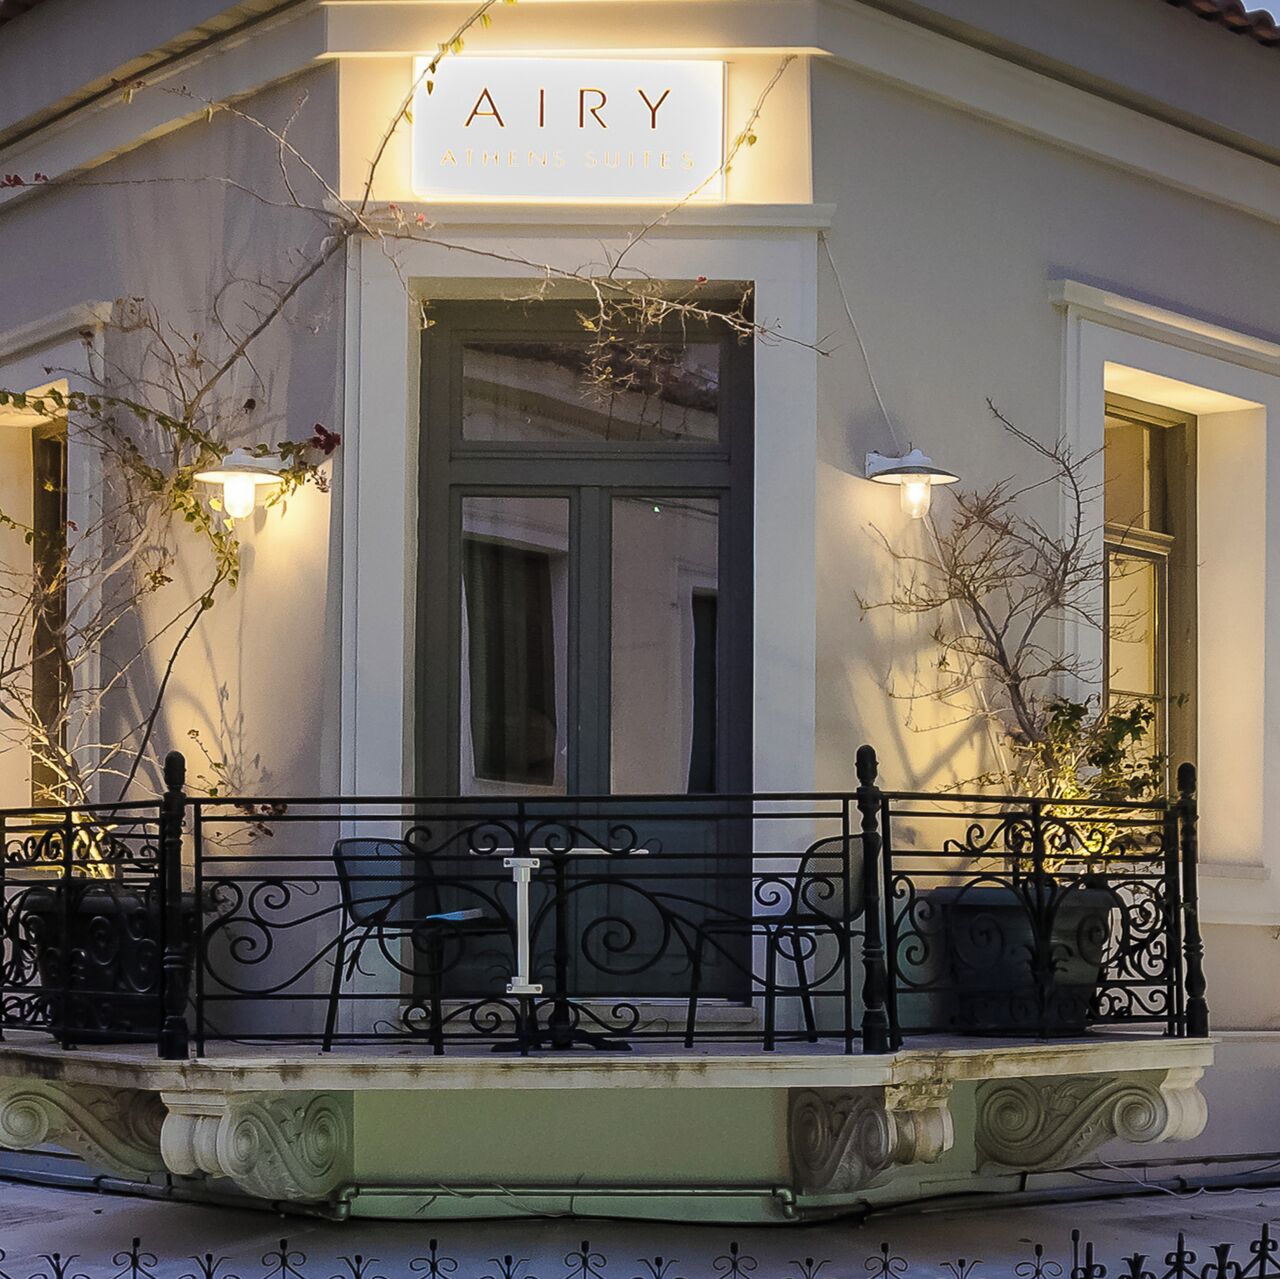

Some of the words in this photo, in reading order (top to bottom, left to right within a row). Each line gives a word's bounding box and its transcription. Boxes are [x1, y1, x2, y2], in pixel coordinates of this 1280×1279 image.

[464, 87, 671, 129] AIRY
[439, 148, 567, 169] ATHENS
[583, 149, 696, 170] SUITES
